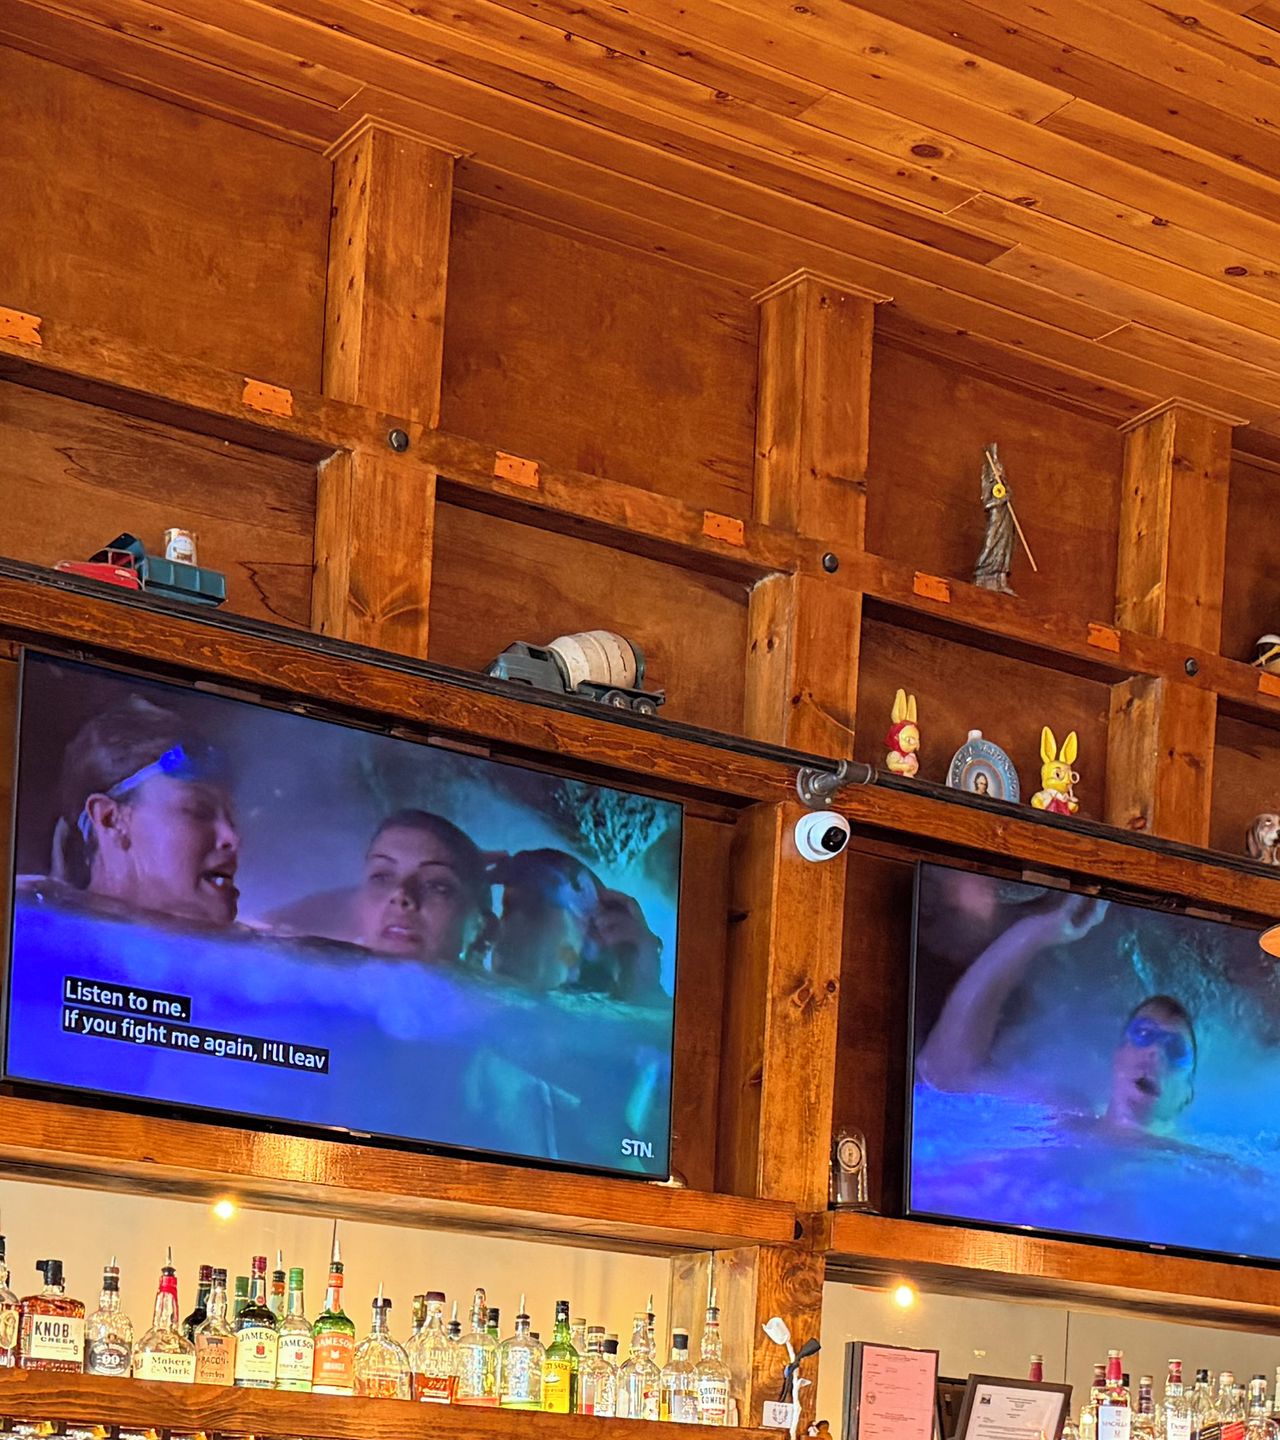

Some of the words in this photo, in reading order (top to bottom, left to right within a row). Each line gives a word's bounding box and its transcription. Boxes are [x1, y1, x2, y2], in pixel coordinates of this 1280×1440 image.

[65, 980, 123, 1007] Listen
[128, 992, 148, 1010] to
[152, 999, 187, 1018] me.
[64, 1009, 79, 1028] If
[82, 1014, 117, 1034] you
[121, 1019, 167, 1044] fight
[171, 1031, 200, 1048] me
[203, 1035, 258, 1061] again,
[262, 1042, 285, 1063] I'll
[288, 1045, 326, 1069] leav
[35, 1320, 69, 1337] KNOB
[40, 1336, 75, 1344] CREEK
[73, 1345, 78, 1355] 9
[151, 1356, 191, 1366] Maker's
[162, 1366, 190, 1375] Mark
[700, 1388, 727, 1396] SOUTHER
